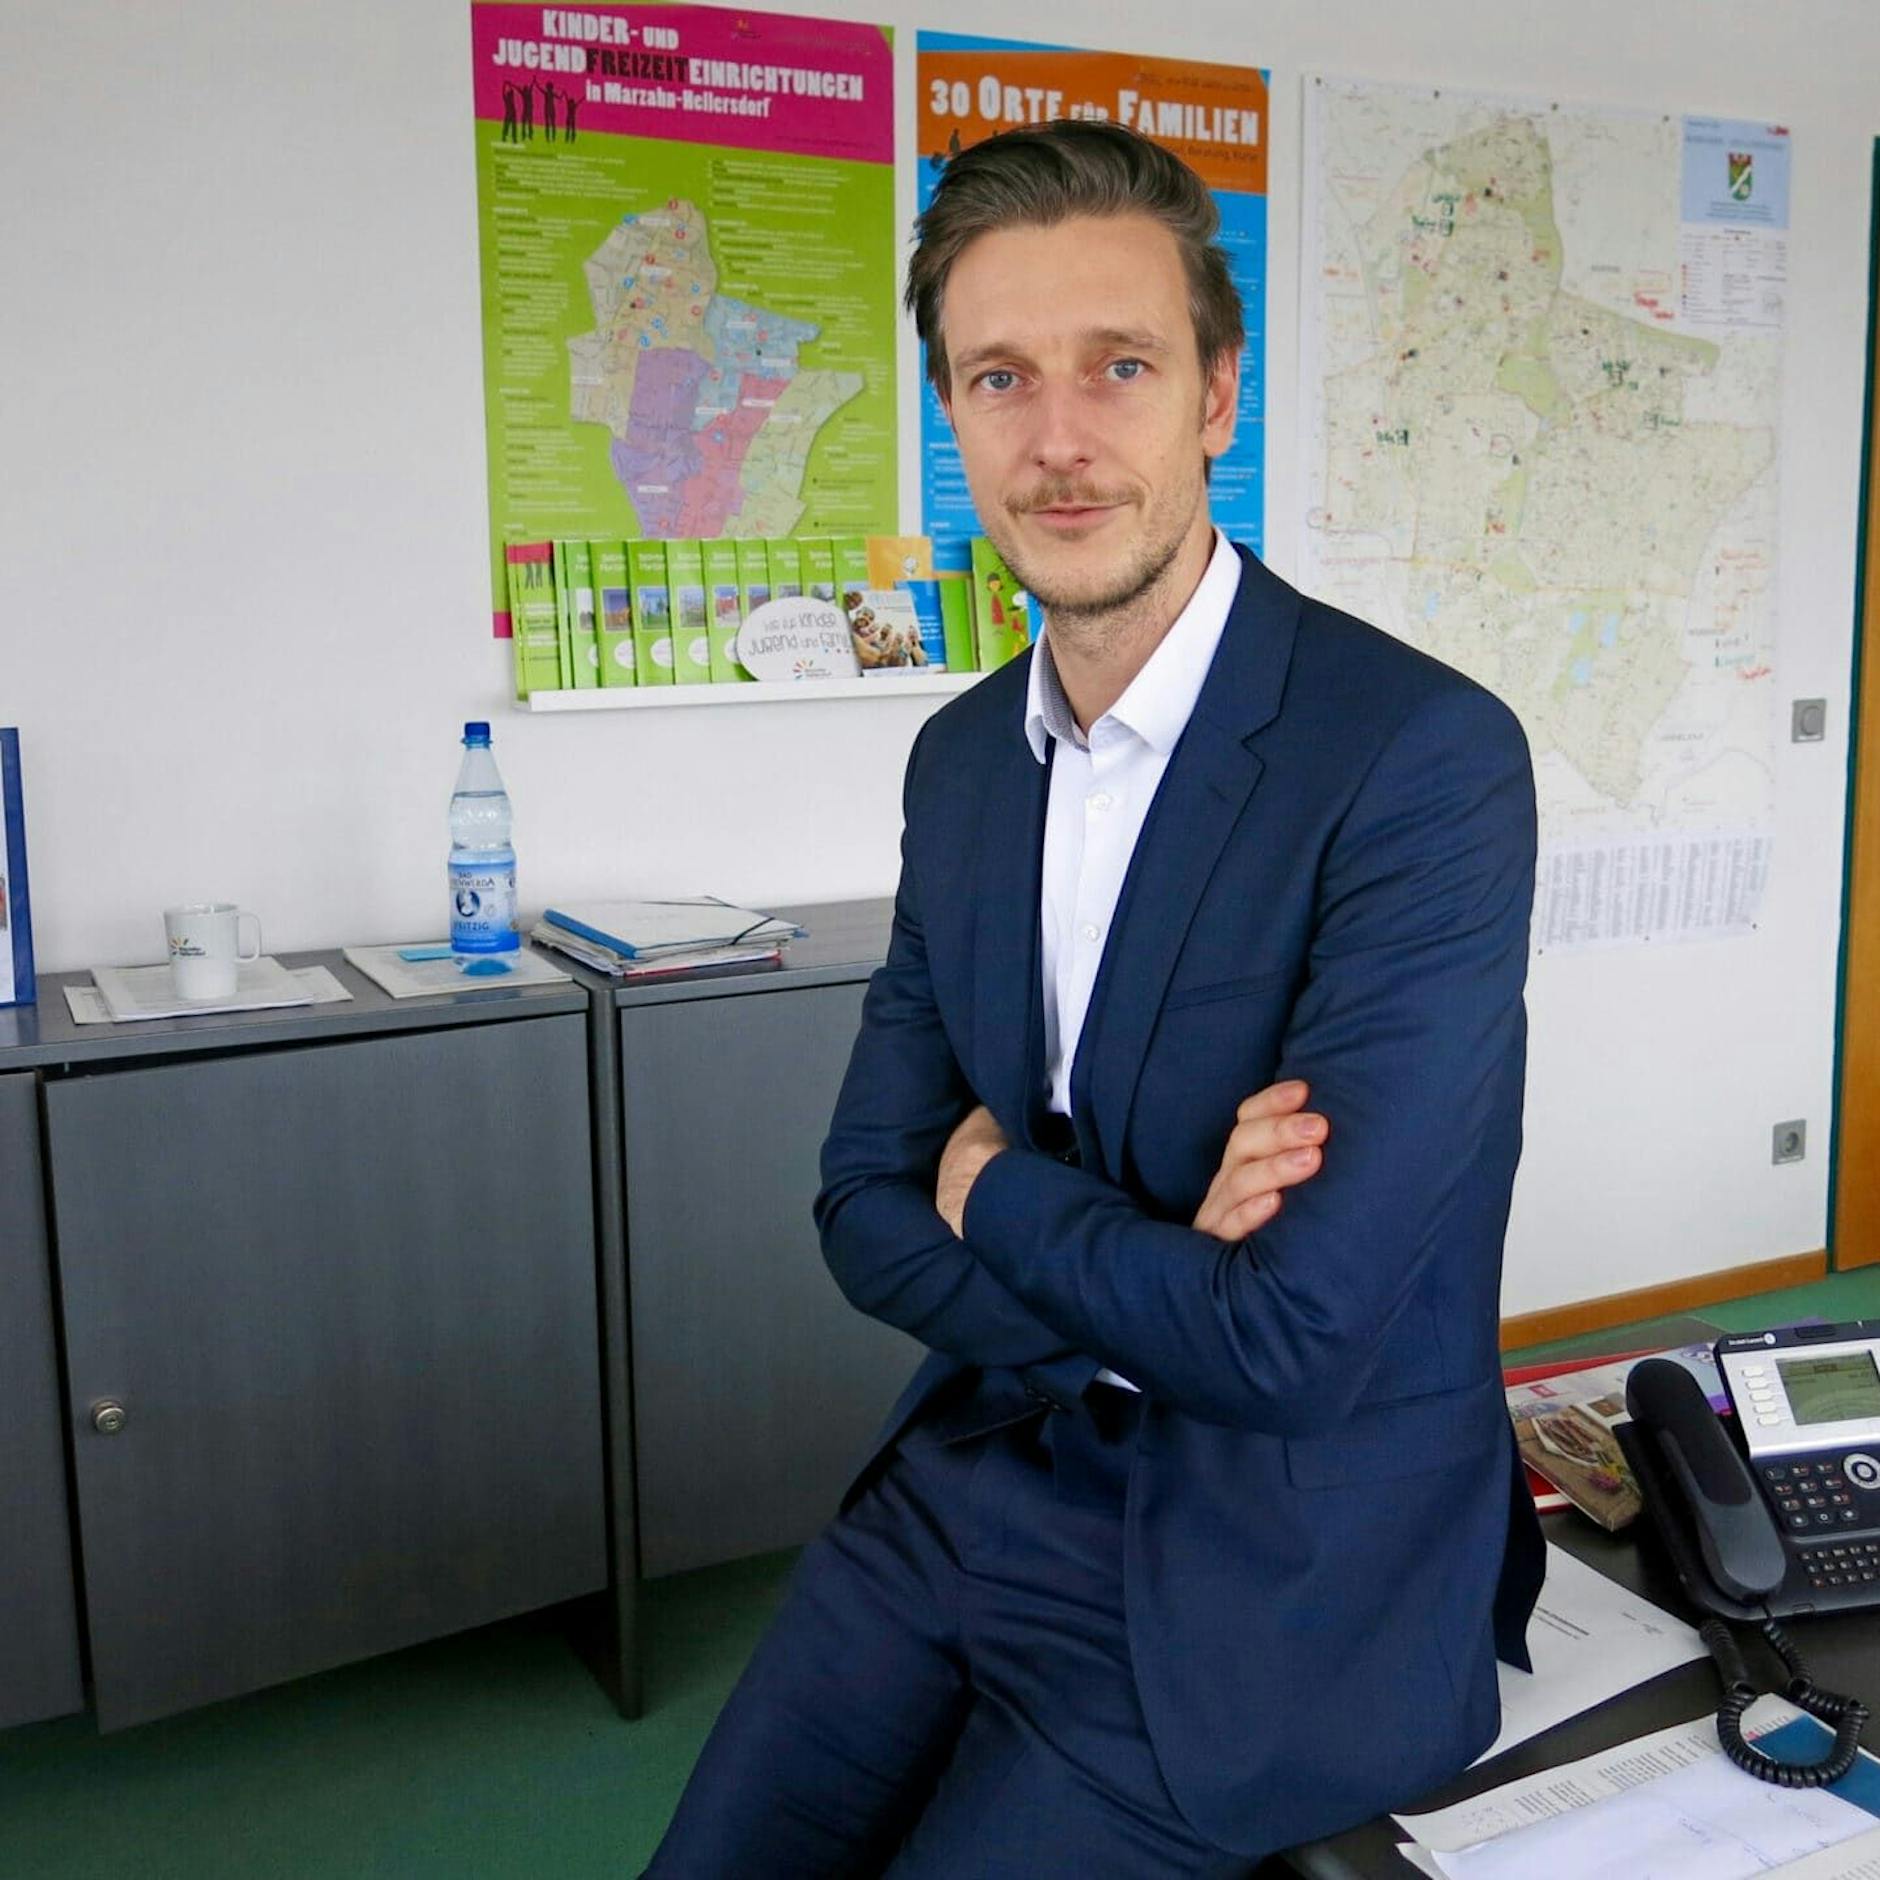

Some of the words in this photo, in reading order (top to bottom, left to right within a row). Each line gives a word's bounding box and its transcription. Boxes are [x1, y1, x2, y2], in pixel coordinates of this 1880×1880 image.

[543, 9, 639, 45] KINDER-
[643, 26, 679, 50] UND
[493, 37, 864, 100] JUGENDFREIZEITEINRICHTUNGEN
[586, 79, 601, 102] in
[604, 81, 772, 119] Marzahn-Hellersdorf
[931, 78, 970, 118] 30
[978, 75, 1064, 123] ORTE
[1118, 89, 1259, 145] FAMILIEN
